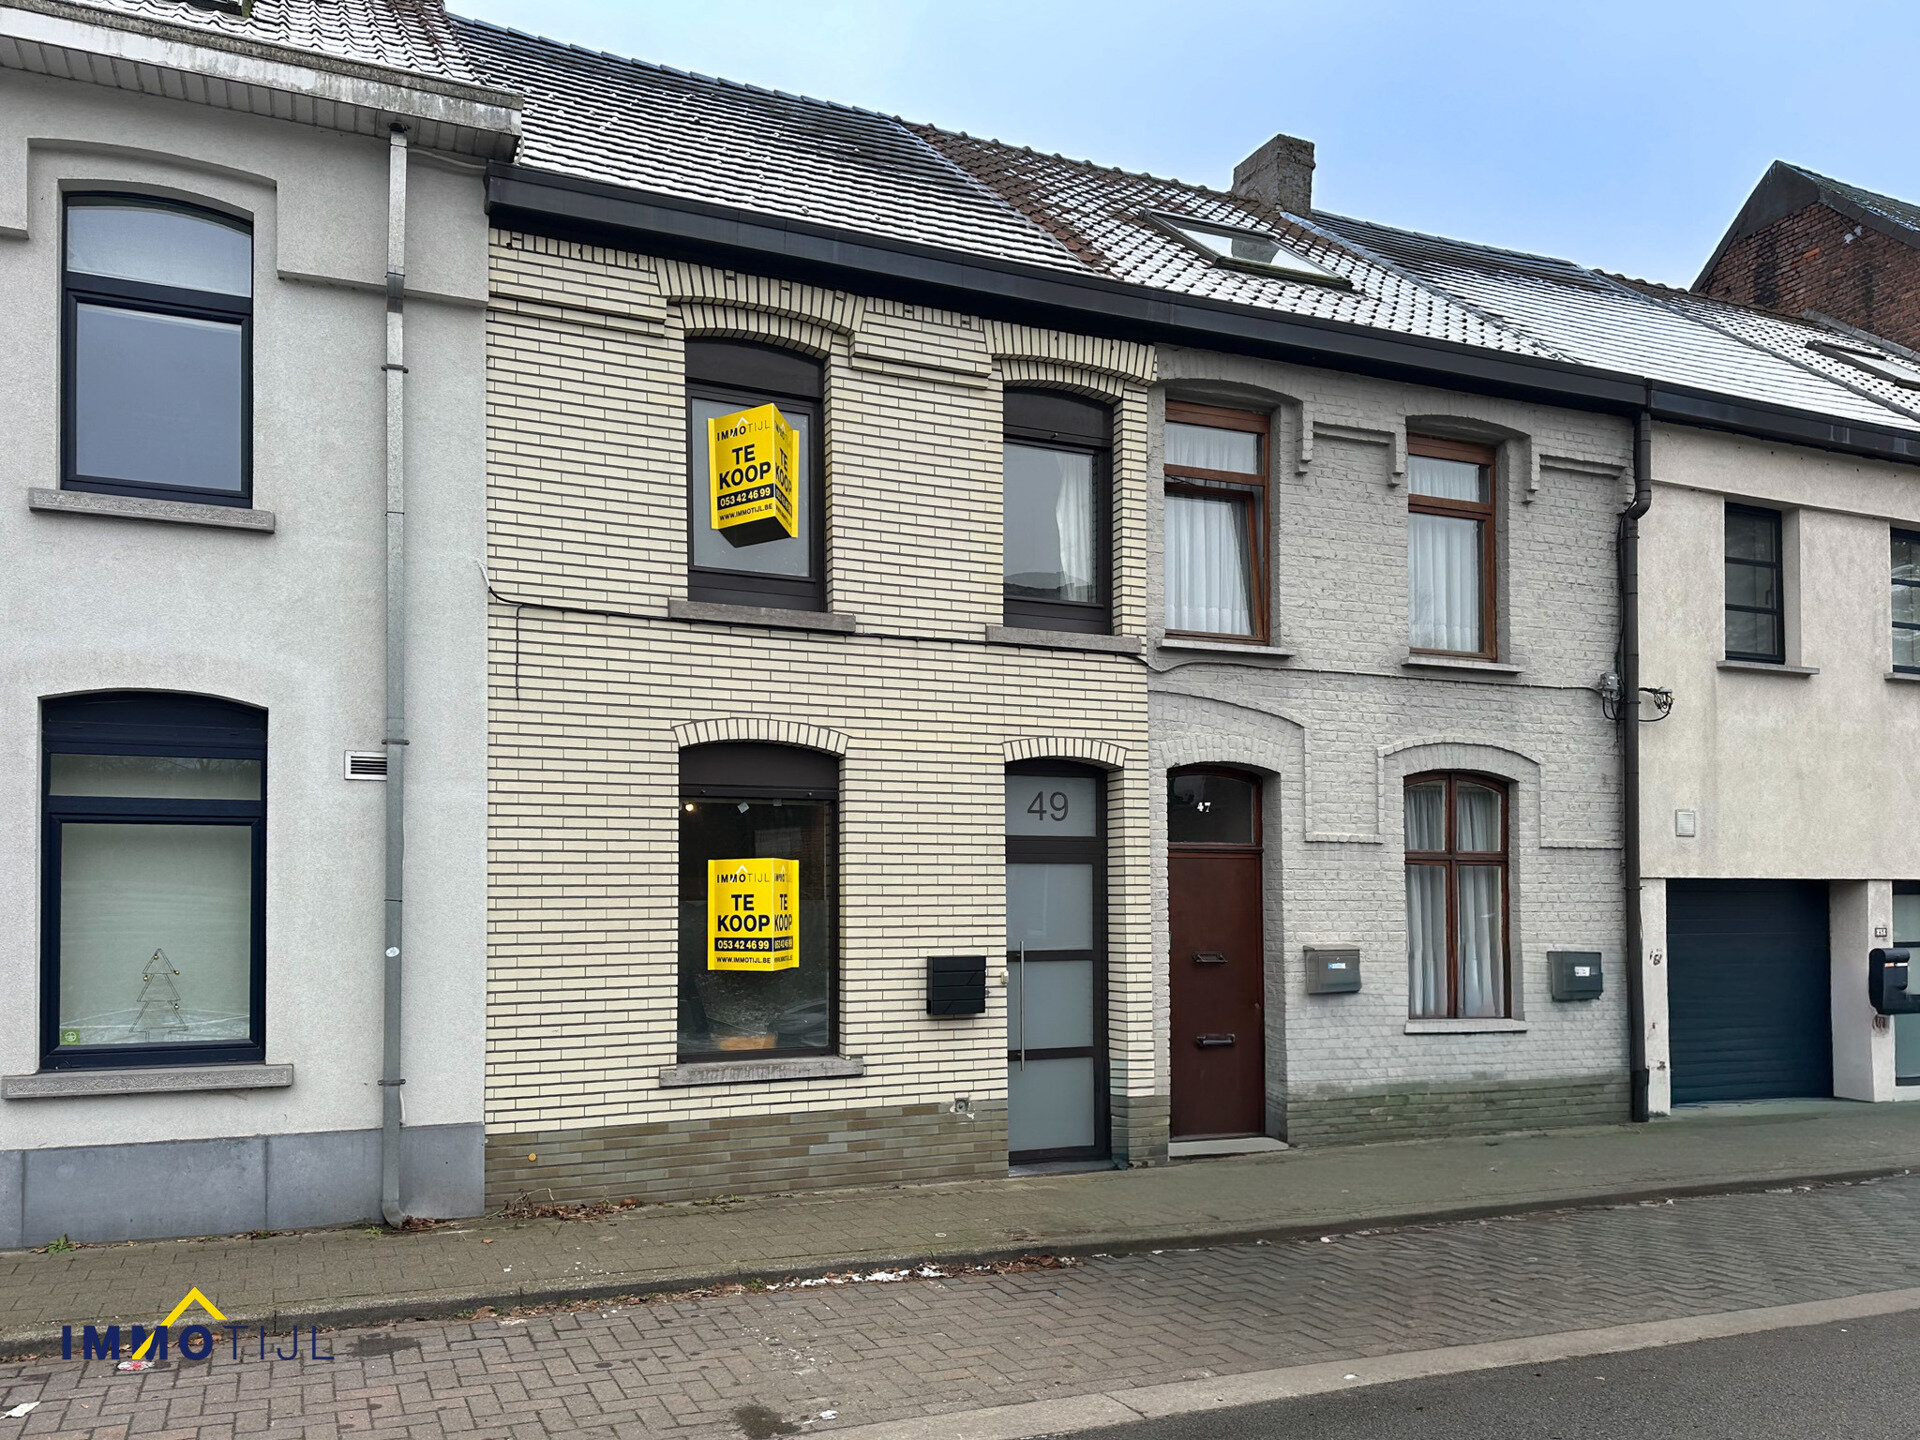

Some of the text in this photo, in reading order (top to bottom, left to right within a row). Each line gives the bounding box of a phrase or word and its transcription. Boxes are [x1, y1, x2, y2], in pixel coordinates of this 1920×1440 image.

[732, 444, 756, 465] TE
[779, 448, 788, 472] TE
[719, 461, 771, 490] KOOP
[720, 486, 771, 507] 053 42 46 99
[719, 503, 773, 521] WWW.IMMOTIJL.BE
[1027, 791, 1069, 822] 49
[1196, 801, 1212, 813] 47
[731, 894, 755, 911] TE
[779, 893, 788, 911] TE
[717, 914, 771, 932] KOOP
[774, 914, 792, 932] KOOP
[717, 940, 733, 950] 053
[734, 940, 745, 950] 42
[746, 940, 757, 950] 46
[758, 940, 769, 950] 99
[716, 956, 771, 964] WWW.IMMOTIJL.BE
